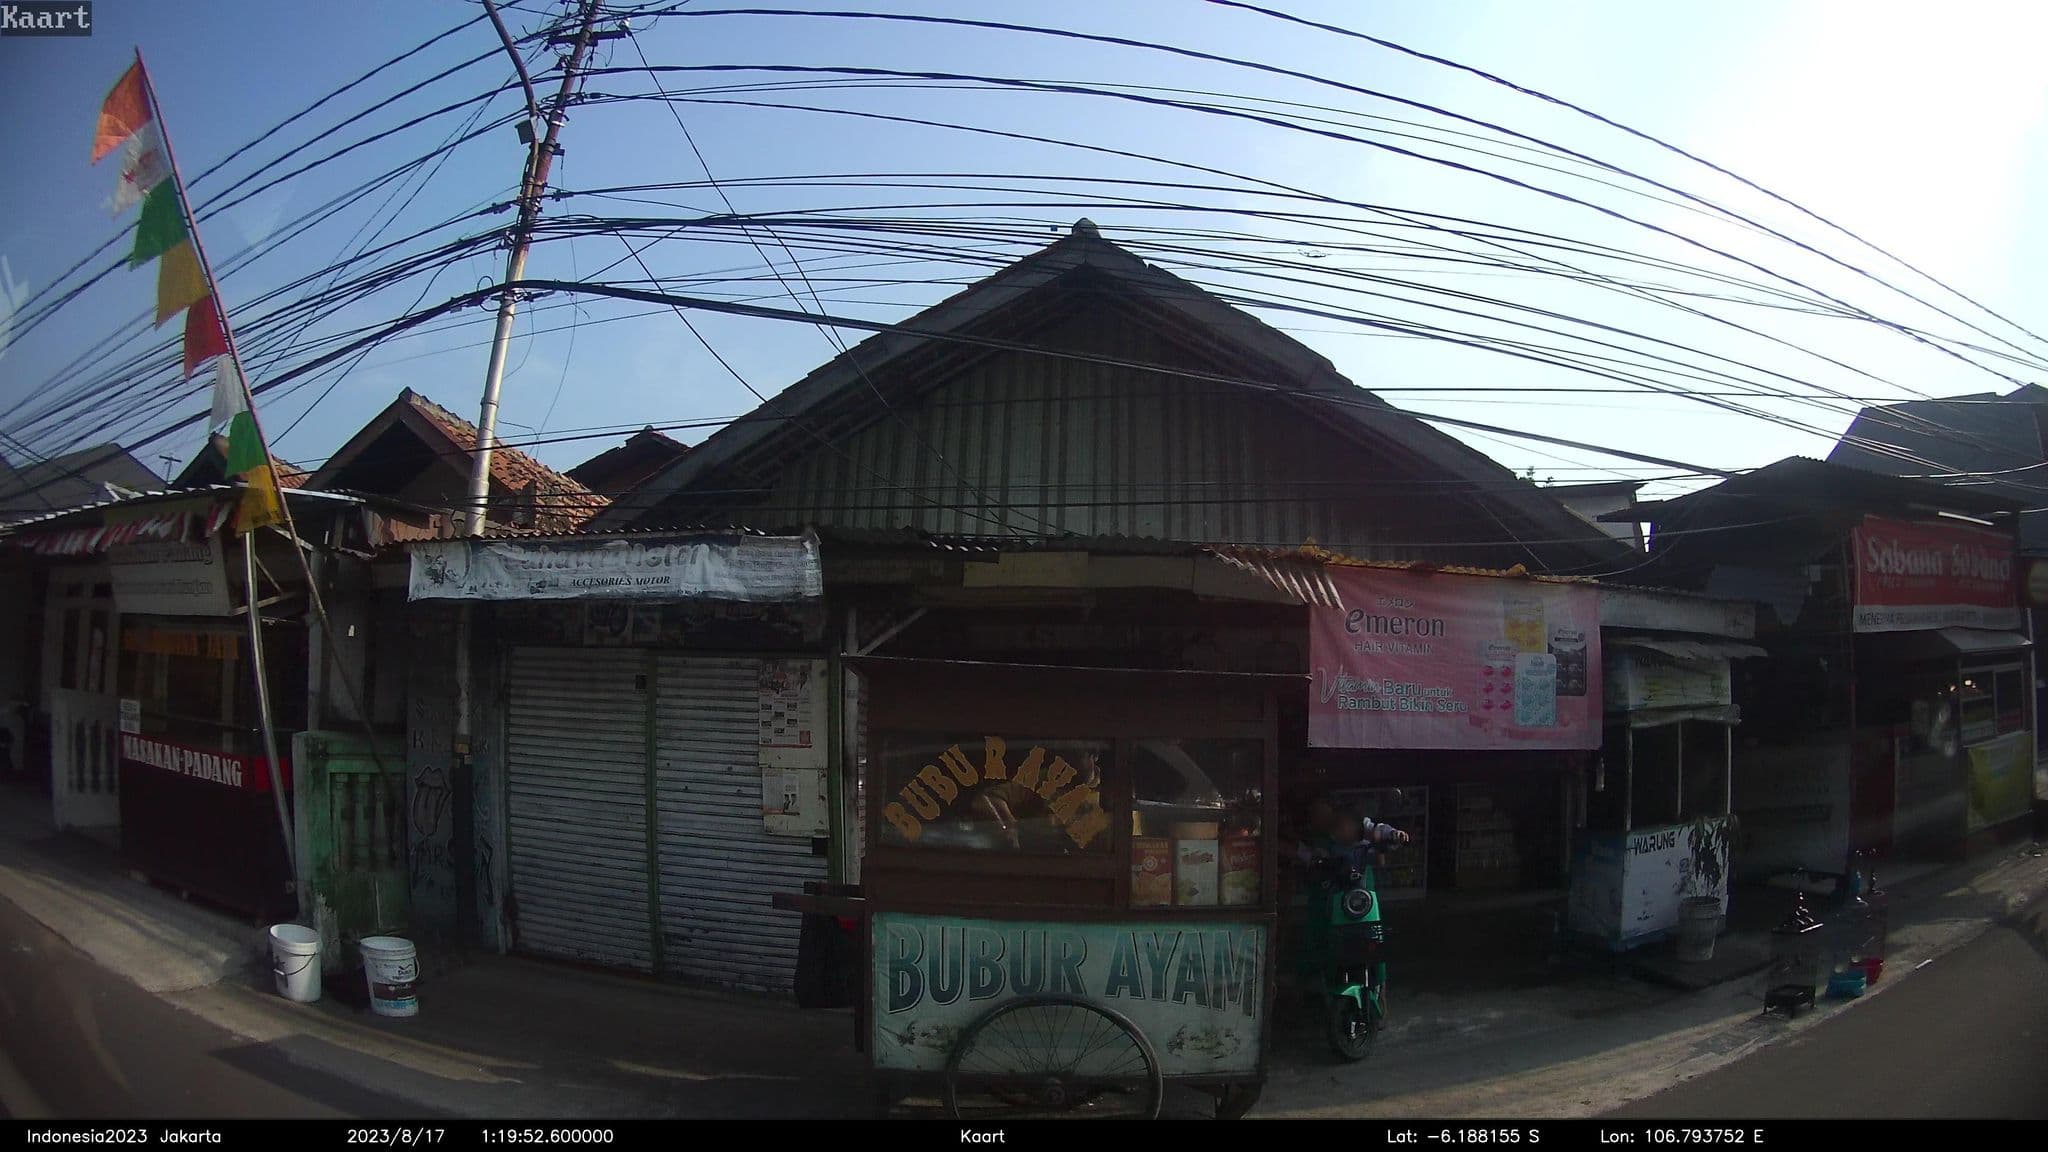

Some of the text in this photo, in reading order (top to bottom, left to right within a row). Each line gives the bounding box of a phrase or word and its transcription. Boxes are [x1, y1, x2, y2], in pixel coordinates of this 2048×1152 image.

[571, 575, 672, 587] ACCESORIES MOTOR
[1344, 608, 1445, 637] emeron
[1354, 641, 1433, 656] HAIR VITAMIN
[1383, 678, 1423, 697] Baru
[1338, 695, 1470, 713] Rambut Bikin Seru
[884, 736, 1008, 841] BUBUR
[1633, 831, 1676, 856] WARUNG
[886, 922, 1261, 1019] BUBUR AYAM
